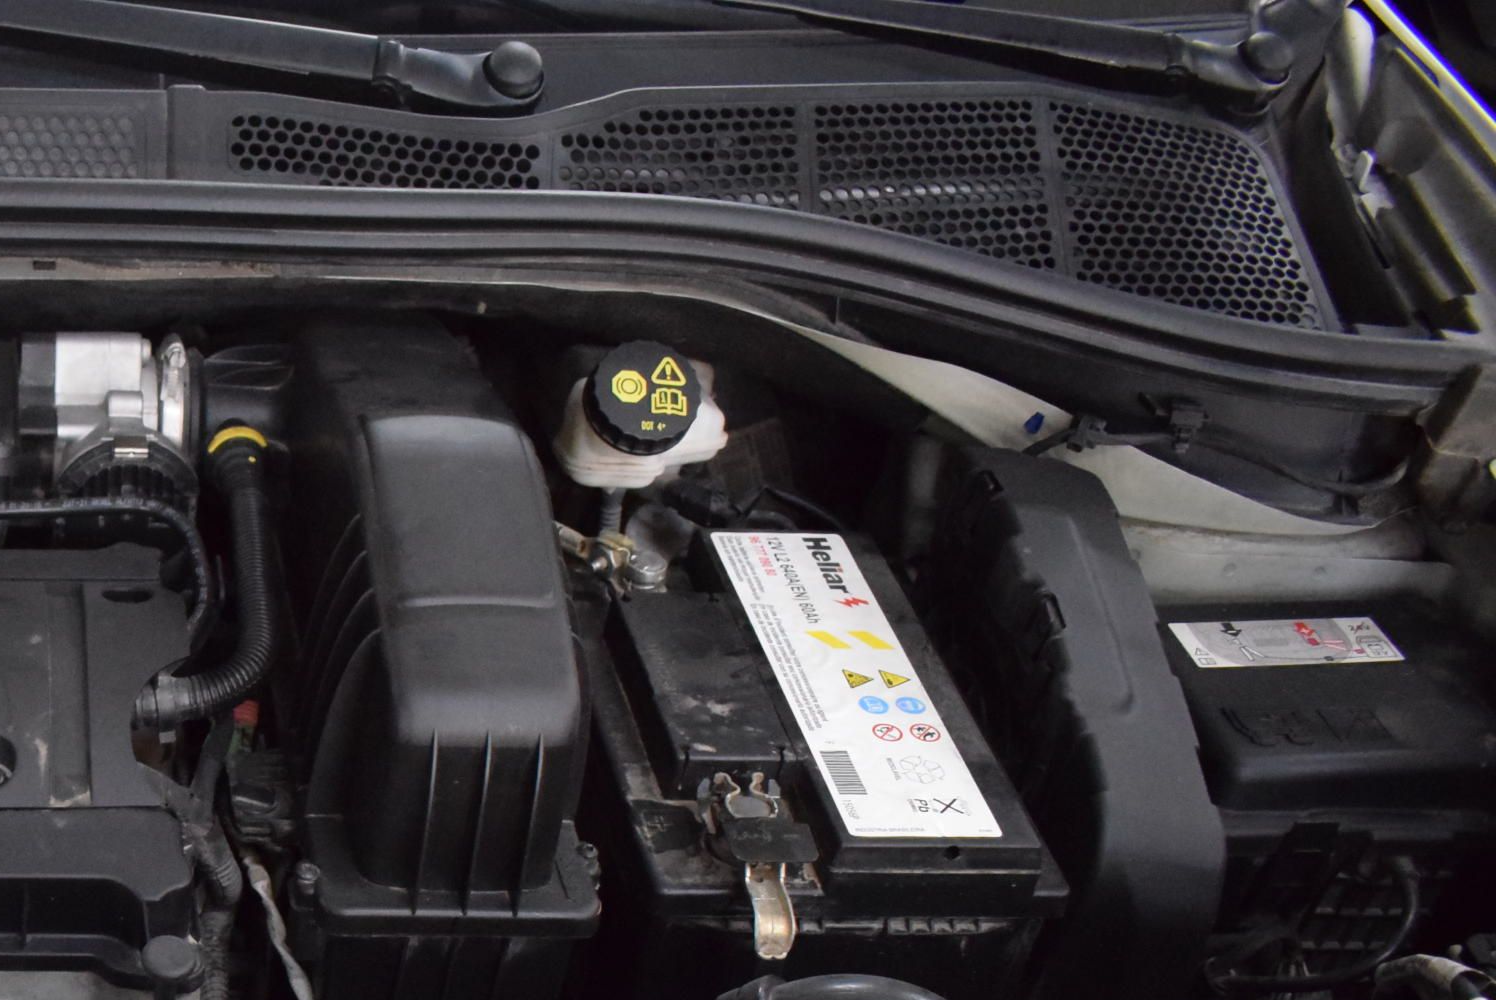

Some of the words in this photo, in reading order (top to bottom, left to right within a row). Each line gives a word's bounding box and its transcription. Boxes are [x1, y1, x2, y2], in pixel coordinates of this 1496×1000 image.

[641, 420, 654, 431] DOT
[766, 536, 784, 551] 12V
[799, 602, 821, 624] 60Ah
[802, 537, 850, 594] Heliar
[913, 798, 930, 813] Pb
